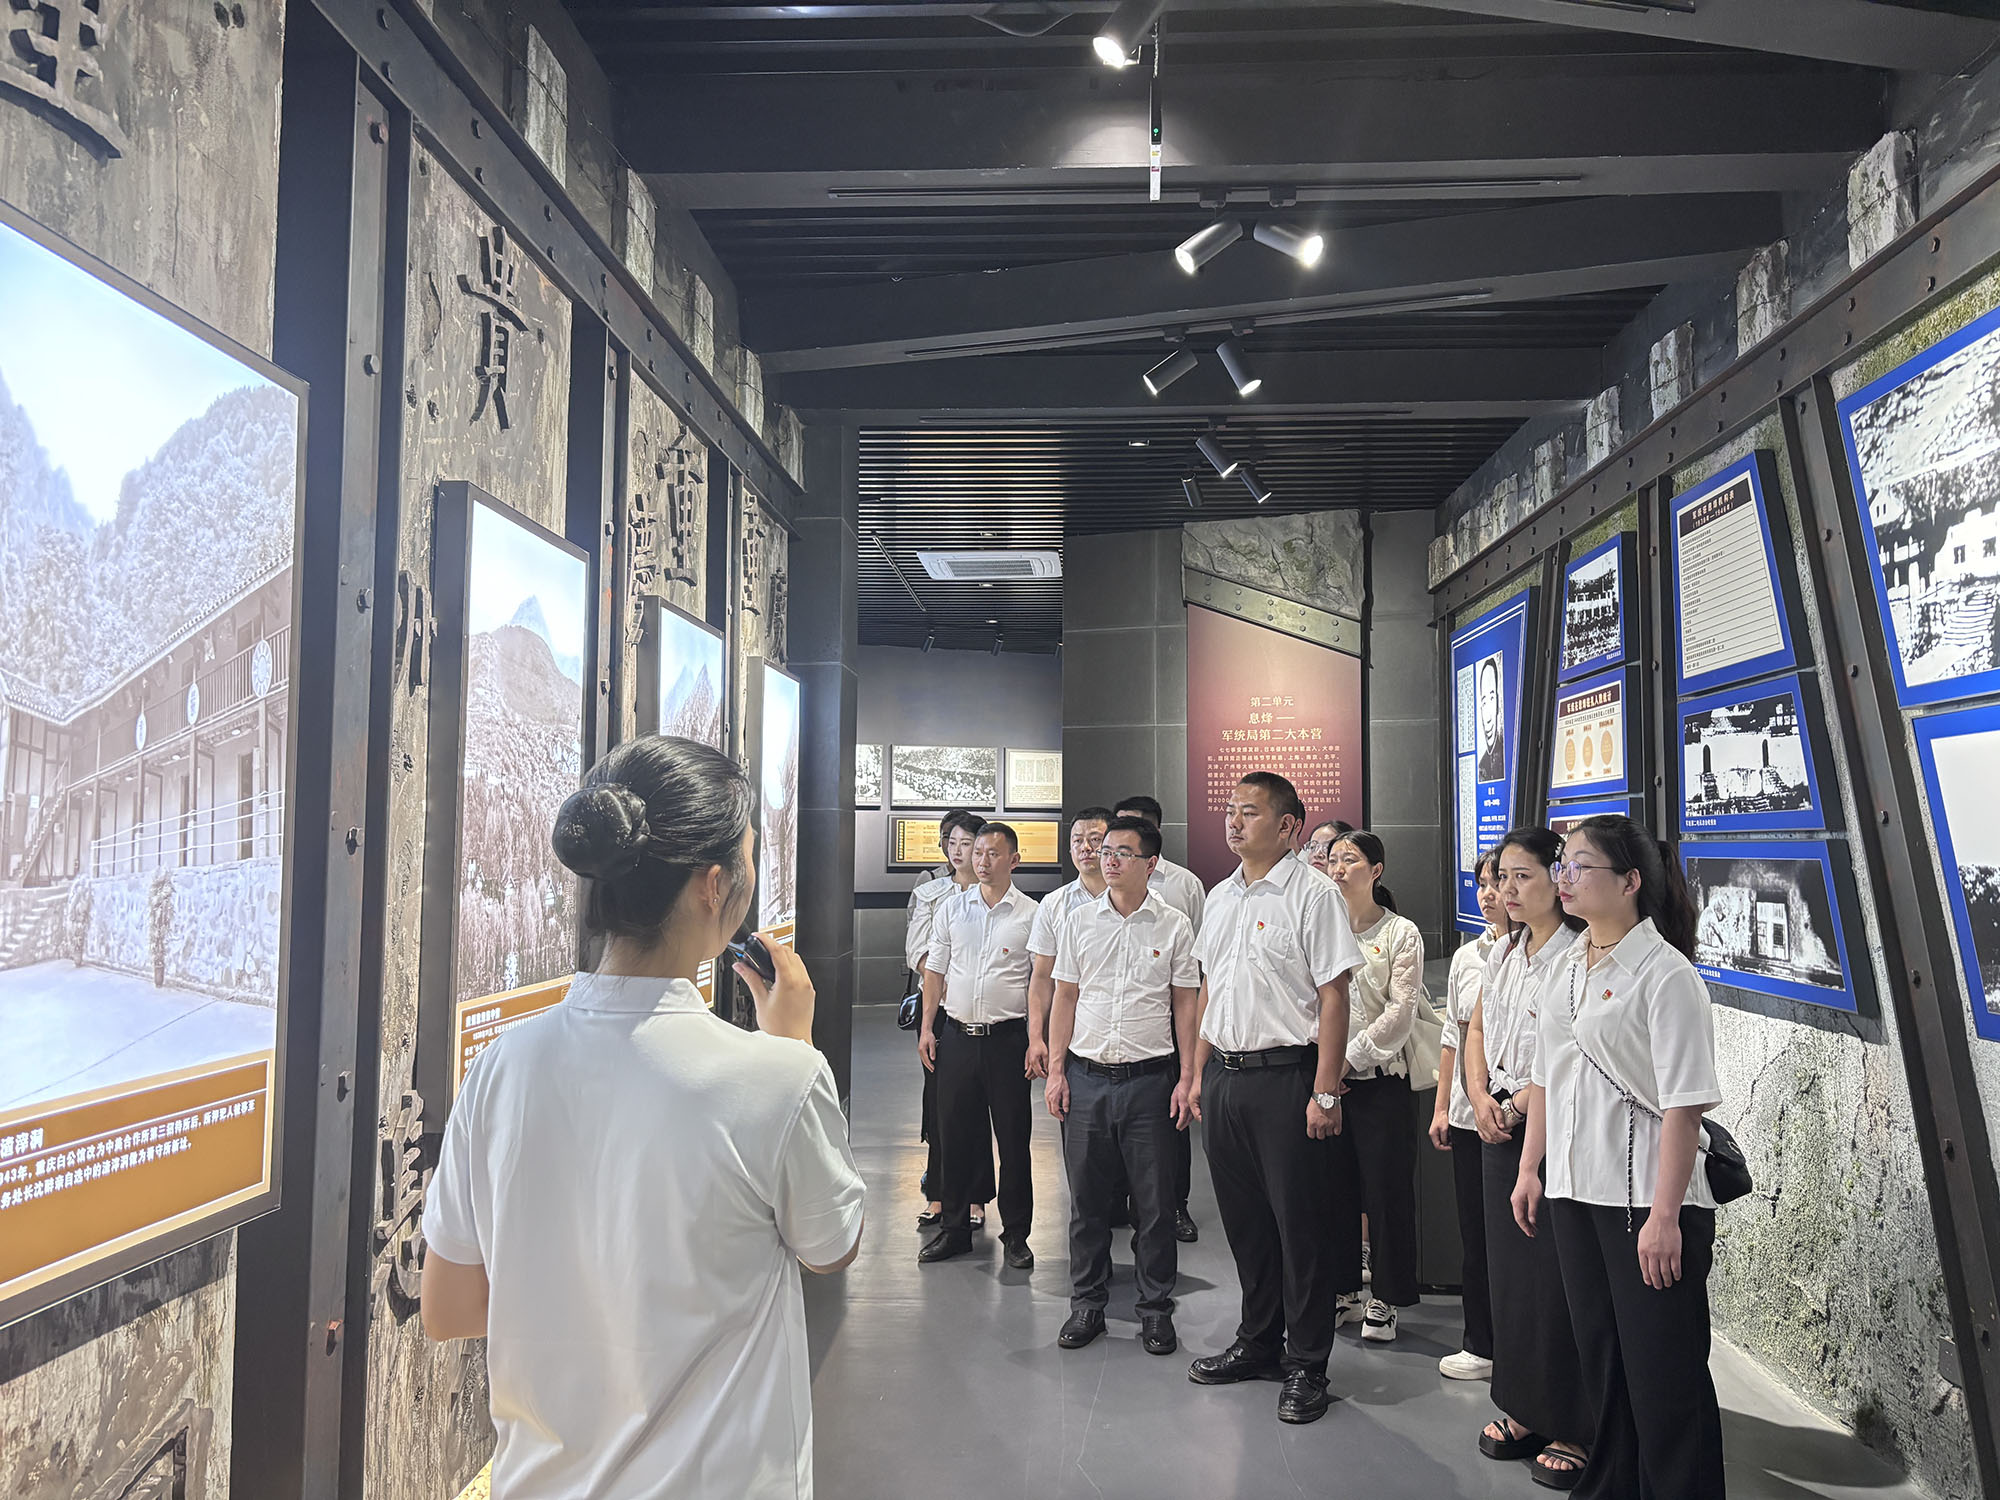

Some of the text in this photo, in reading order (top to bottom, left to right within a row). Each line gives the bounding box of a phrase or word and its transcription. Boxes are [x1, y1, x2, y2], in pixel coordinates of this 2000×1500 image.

[1250, 696, 1295, 707] 第二单元
[1222, 728, 1323, 741] 军统局第二大本营
[0, 1127, 44, 1159] 渣滓洞
